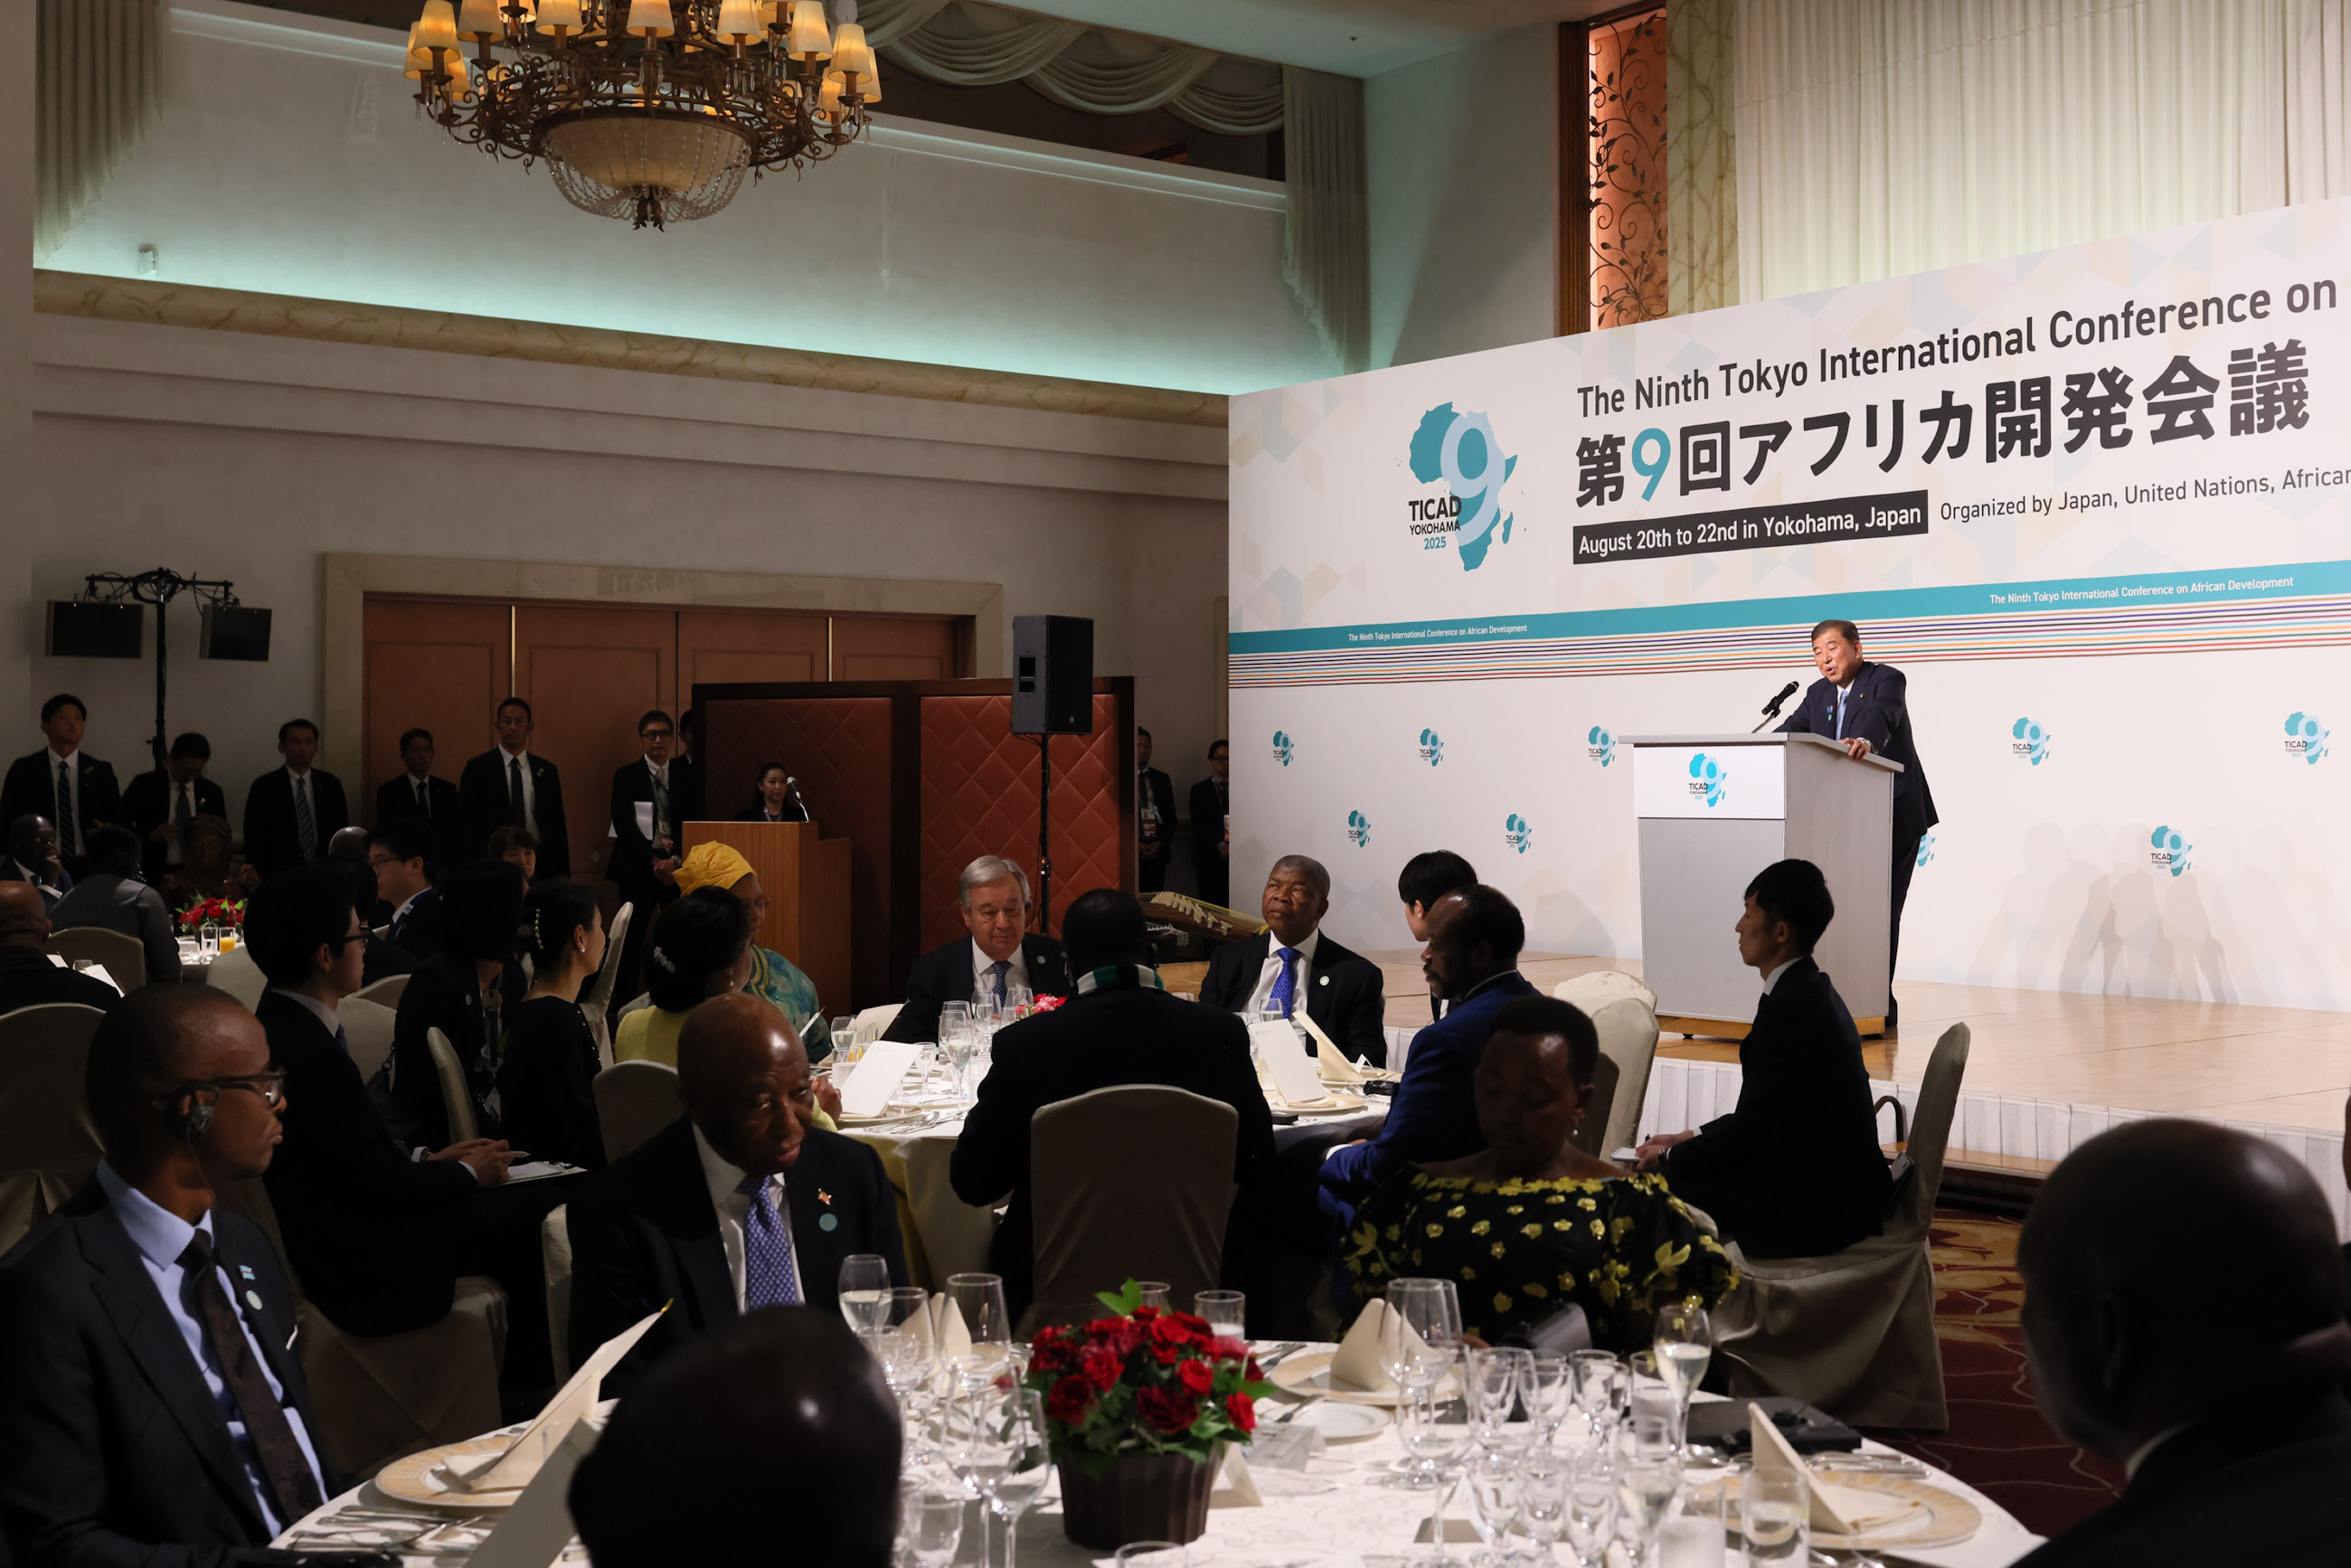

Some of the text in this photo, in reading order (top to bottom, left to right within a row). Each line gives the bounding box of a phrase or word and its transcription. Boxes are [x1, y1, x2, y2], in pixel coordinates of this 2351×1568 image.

[1577, 279, 2337, 418] The Ninth Tokyo International Conference on
[1575, 338, 2310, 508] 第9回アフリカ開発会議
[1409, 496, 1462, 522] TICAD
[1940, 496, 2026, 523] Organized
[2033, 495, 2053, 516] by
[2058, 491, 2118, 513] Japan,
[2125, 480, 2186, 505] United
[2195, 476, 2275, 498] Nations,
[1410, 520, 1461, 535] YOKOHAMA
[1579, 506, 1921, 558] August 20th to 22nd in Yokohama, Japan
[1423, 536, 1447, 550] 2025
[1989, 577, 2294, 604] The Ninth Tokyo International Conference on African Development
[1348, 633, 1358, 641] The
[1359, 632, 1374, 641] Ninth
[1374, 631, 1391, 642] Tokyo
[1391, 629, 1426, 639] International
[1426, 628, 1459, 638] Conference
[1468, 627, 1488, 636] African
[1488, 624, 1528, 635] Development
